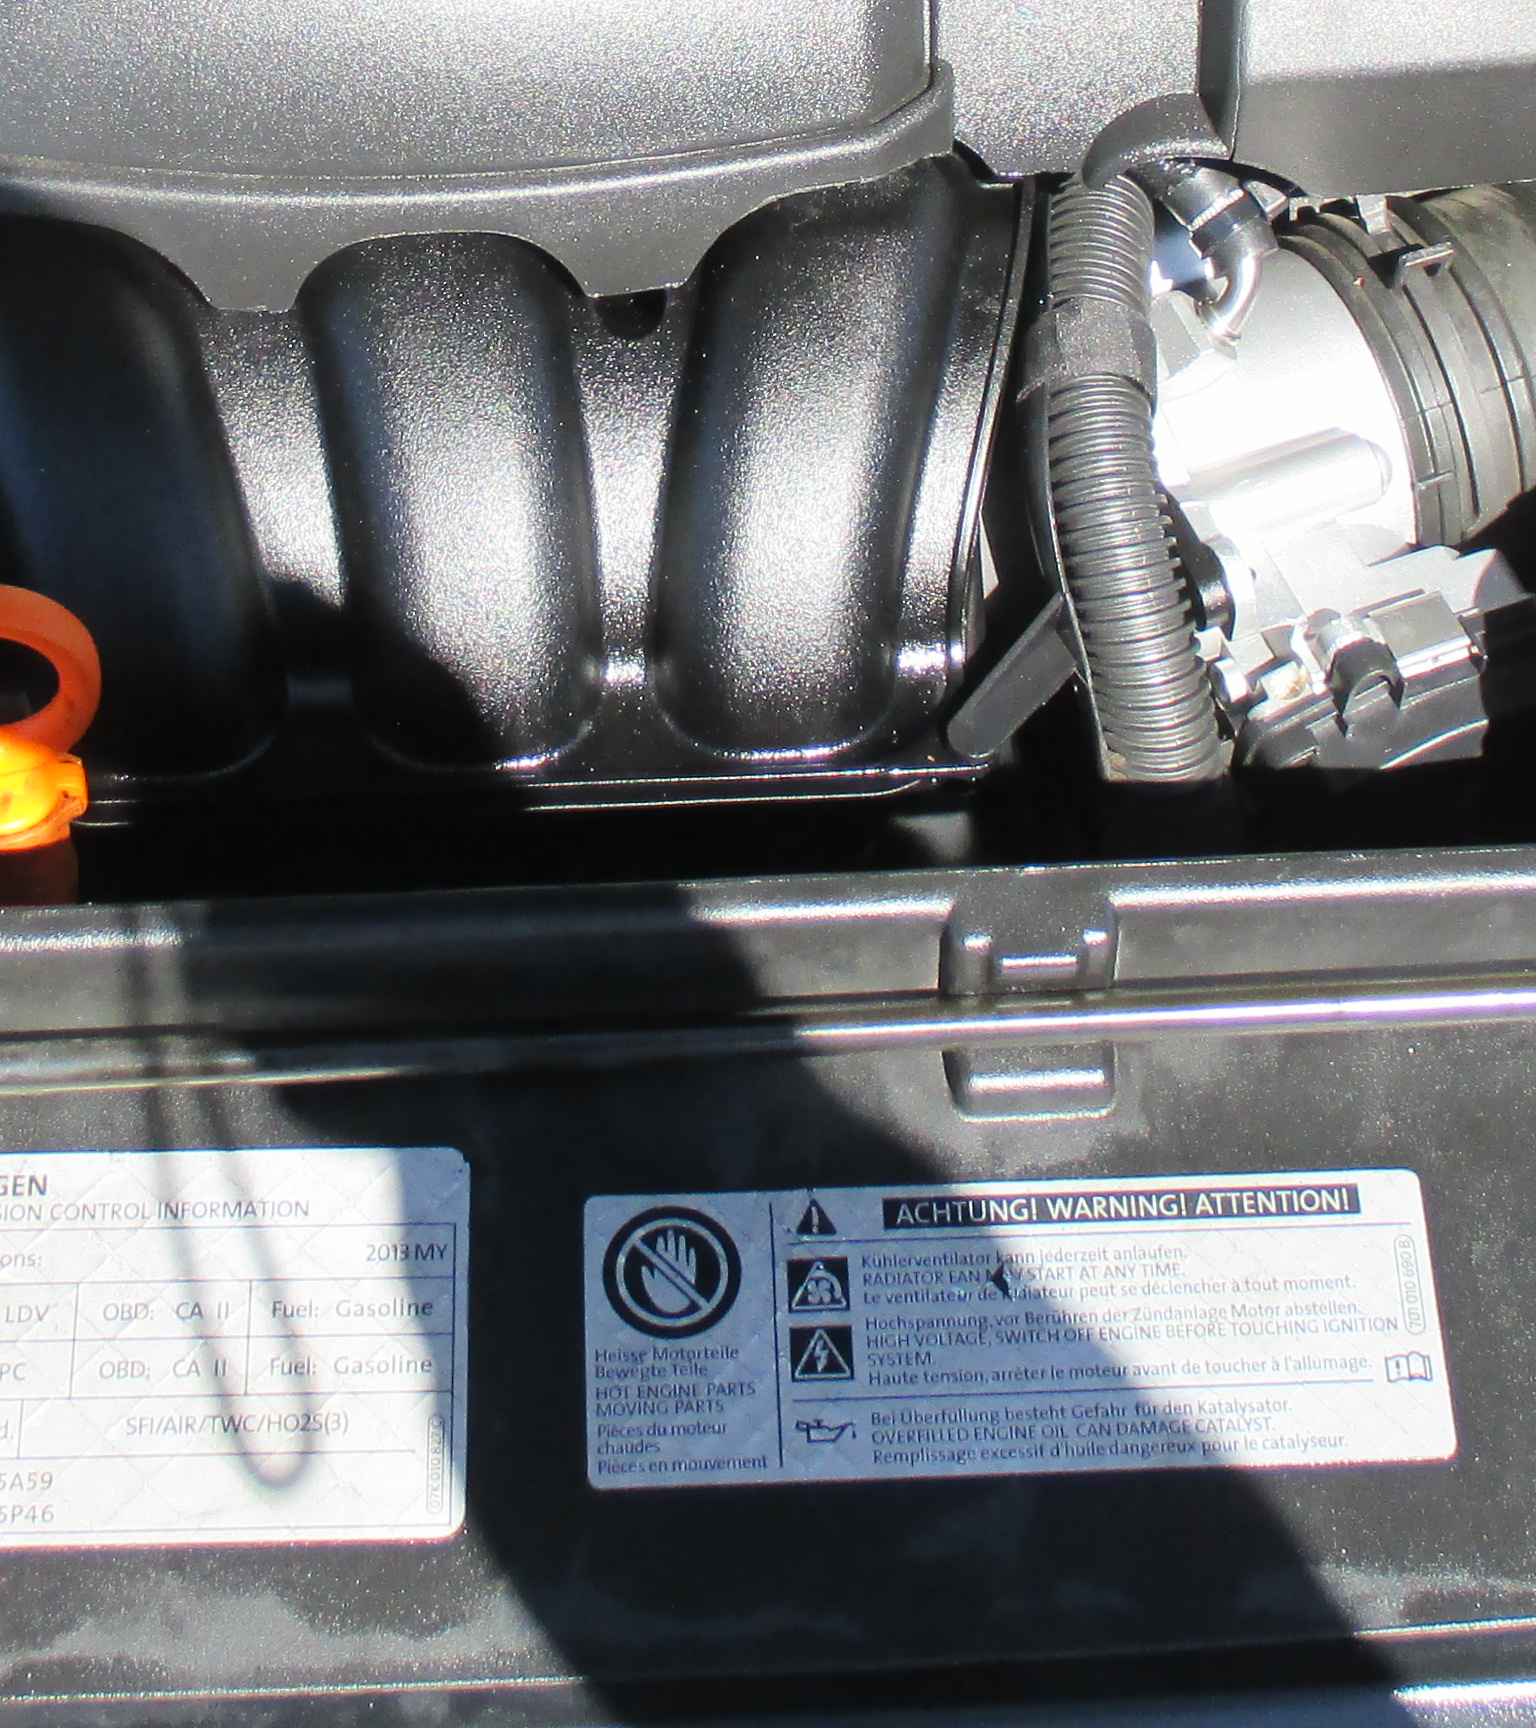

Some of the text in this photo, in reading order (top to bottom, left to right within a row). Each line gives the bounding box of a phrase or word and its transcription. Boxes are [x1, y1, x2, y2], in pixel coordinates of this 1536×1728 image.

[49, 1202, 150, 1221] CONTROL
[157, 1199, 309, 1219] INFORMATION
[895, 1188, 1349, 1225] ACHTUNG! WARNING! ATTENTION!
[366, 1243, 446, 1261] 2013 MY
[861, 1251, 990, 1268] Kühlerventilator
[1038, 1247, 1108, 1265] jederzeit
[1112, 1244, 1188, 1261] anlaufen,
[862, 1271, 944, 1285] RADIATOR
[949, 1269, 979, 1282] FAN
[1026, 1266, 1078, 1280] START
[1082, 1265, 1098, 1278] AT
[1102, 1264, 1136, 1277] ANY
[1141, 1262, 1185, 1276] TIME.
[863, 1274, 1356, 1304] Le ventilateur de peut se déclencher à tout moment.
[4, 1304, 50, 1323] LDV
[102, 1303, 154, 1321] OBD:
[175, 1302, 203, 1320] CA
[271, 1298, 433, 1318] Fuel: Gasoline
[865, 1300, 1360, 1333] Hochspannung, vor Berühren der Zündanlage Motor abstellen.
[866, 1318, 1398, 1348] HIGH VOLTAGE, SWITCH OFF ENGINE BEFORE TOUCHING IGNITION
[99, 1360, 151, 1379] OBD:
[172, 1359, 201, 1377] CA
[269, 1354, 432, 1375] Fuel: Gasoline
[868, 1370, 918, 1385] Haute
[923, 1368, 988, 1385] tension,
[1050, 1365, 1064, 1378] le
[1068, 1363, 1127, 1378] moteur
[1132, 1362, 1175, 1376] avant
[1180, 1361, 1200, 1374] de
[1204, 1358, 1266, 1373] toucher
[1270, 1358, 1280, 1371] à
[1284, 1355, 1373, 1374] l'allumage.
[596, 1381, 755, 1399] HOT ENGINE PARTS
[596, 1399, 723, 1416] MOVING PARTS
[870, 1411, 895, 1425] Bei
[1004, 1405, 1066, 1420] besteht
[1070, 1403, 1127, 1418] Gefahr
[1134, 1402, 1157, 1416] für
[1162, 1400, 1193, 1415] den
[1197, 1397, 1292, 1417] Katalysator.
[125, 1412, 349, 1437] SFI/AIR/TWC/HO2S(3)
[871, 1427, 969, 1443] OVERFILLED
[973, 1425, 1036, 1440] ENGINE
[1075, 1422, 1112, 1436] CAN
[1116, 1420, 1190, 1435] DAMAGE
[1195, 1417, 1275, 1432] CATALYST.
[872, 1433, 1348, 1466] Remplissage excessif d'huile dangereux pour le catalyseur.
